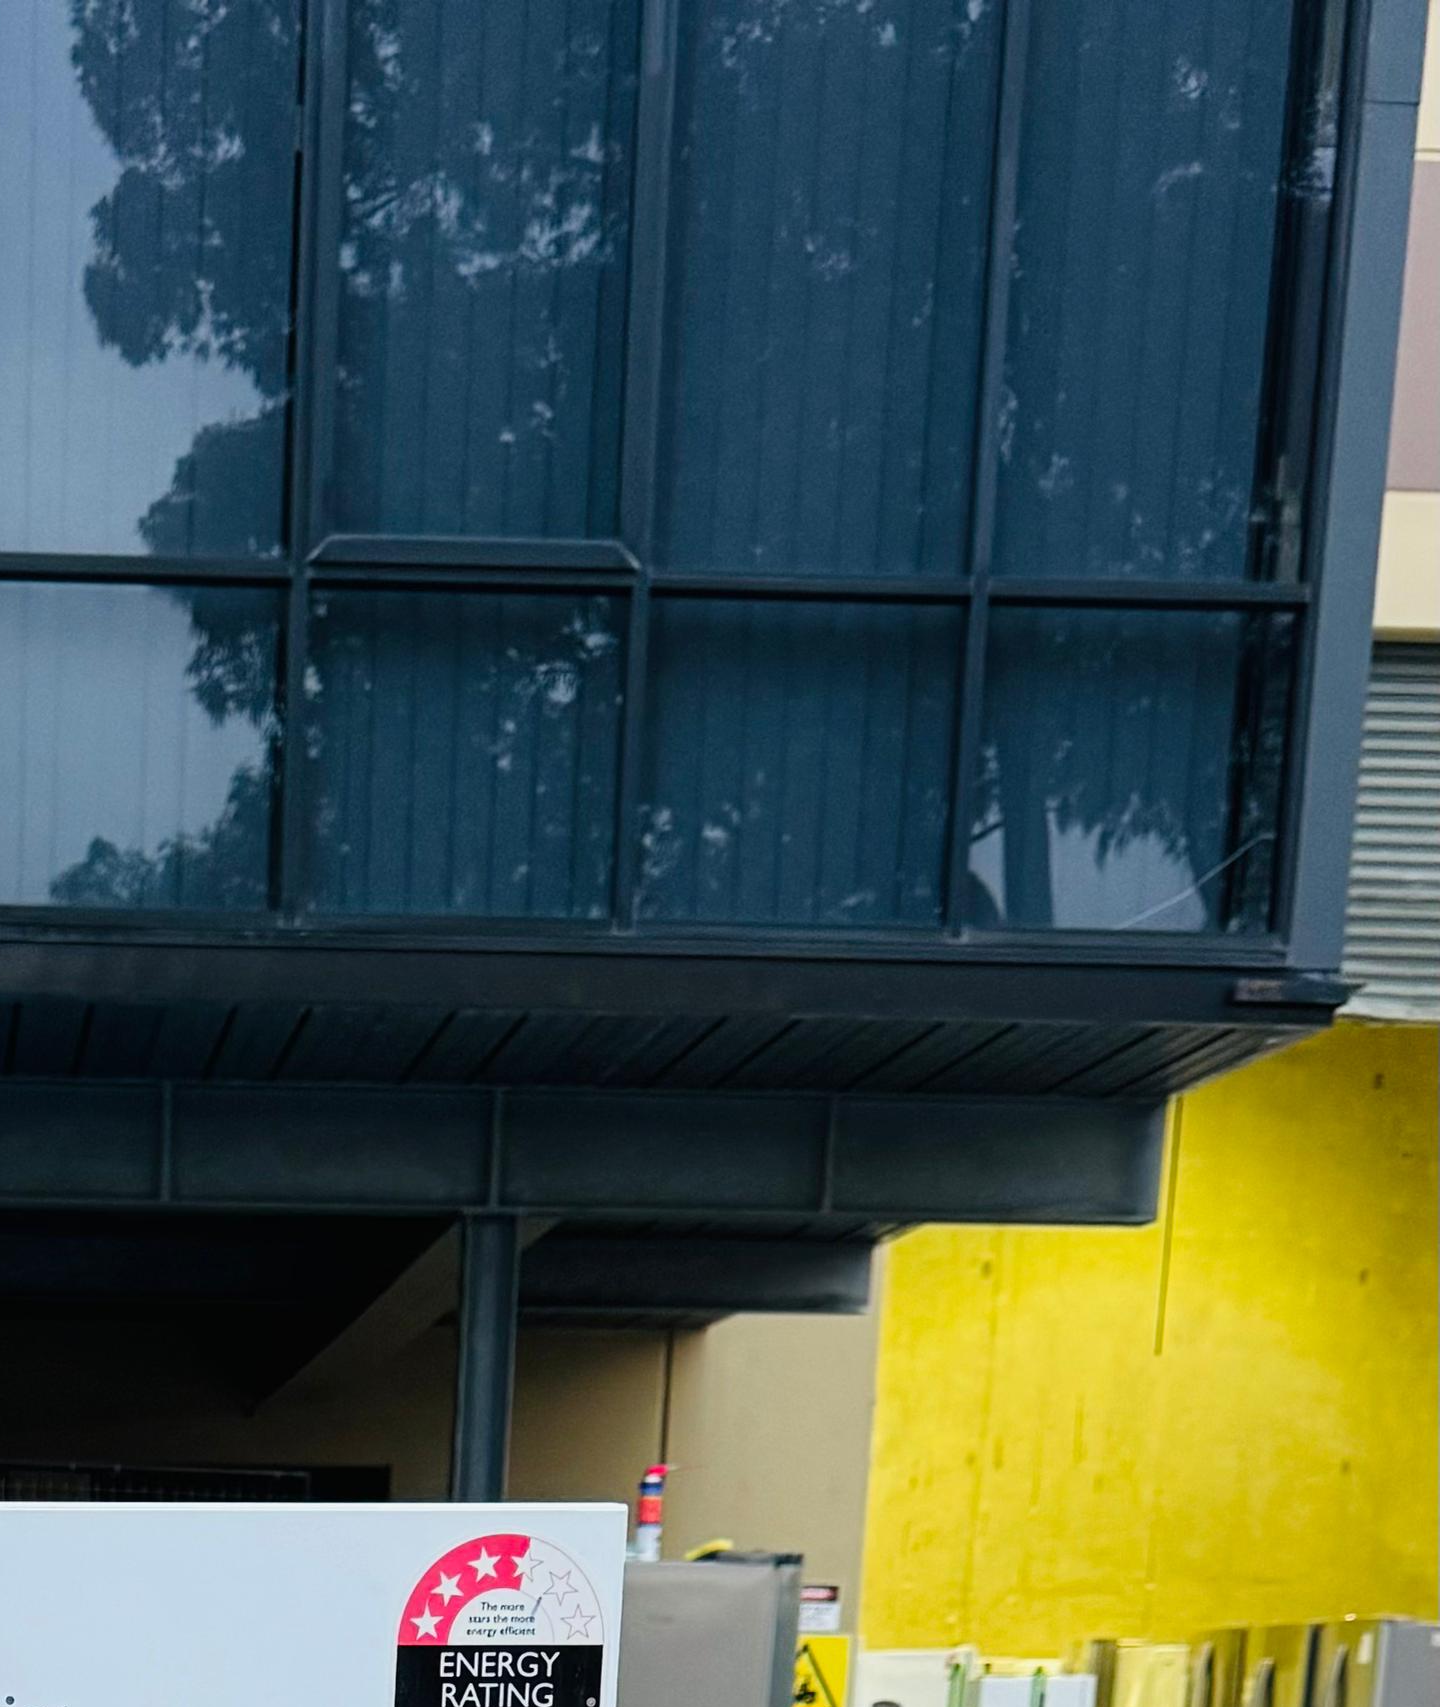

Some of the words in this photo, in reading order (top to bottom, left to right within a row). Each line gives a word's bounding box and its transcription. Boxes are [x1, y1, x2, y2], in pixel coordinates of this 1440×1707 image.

[481, 1602, 498, 1611] The
[493, 1615, 508, 1623] the
[467, 1628, 497, 1638] energy
[500, 1626, 535, 1636] efficient
[439, 1651, 560, 1678] ENERGY
[441, 1682, 554, 1707] RATING
